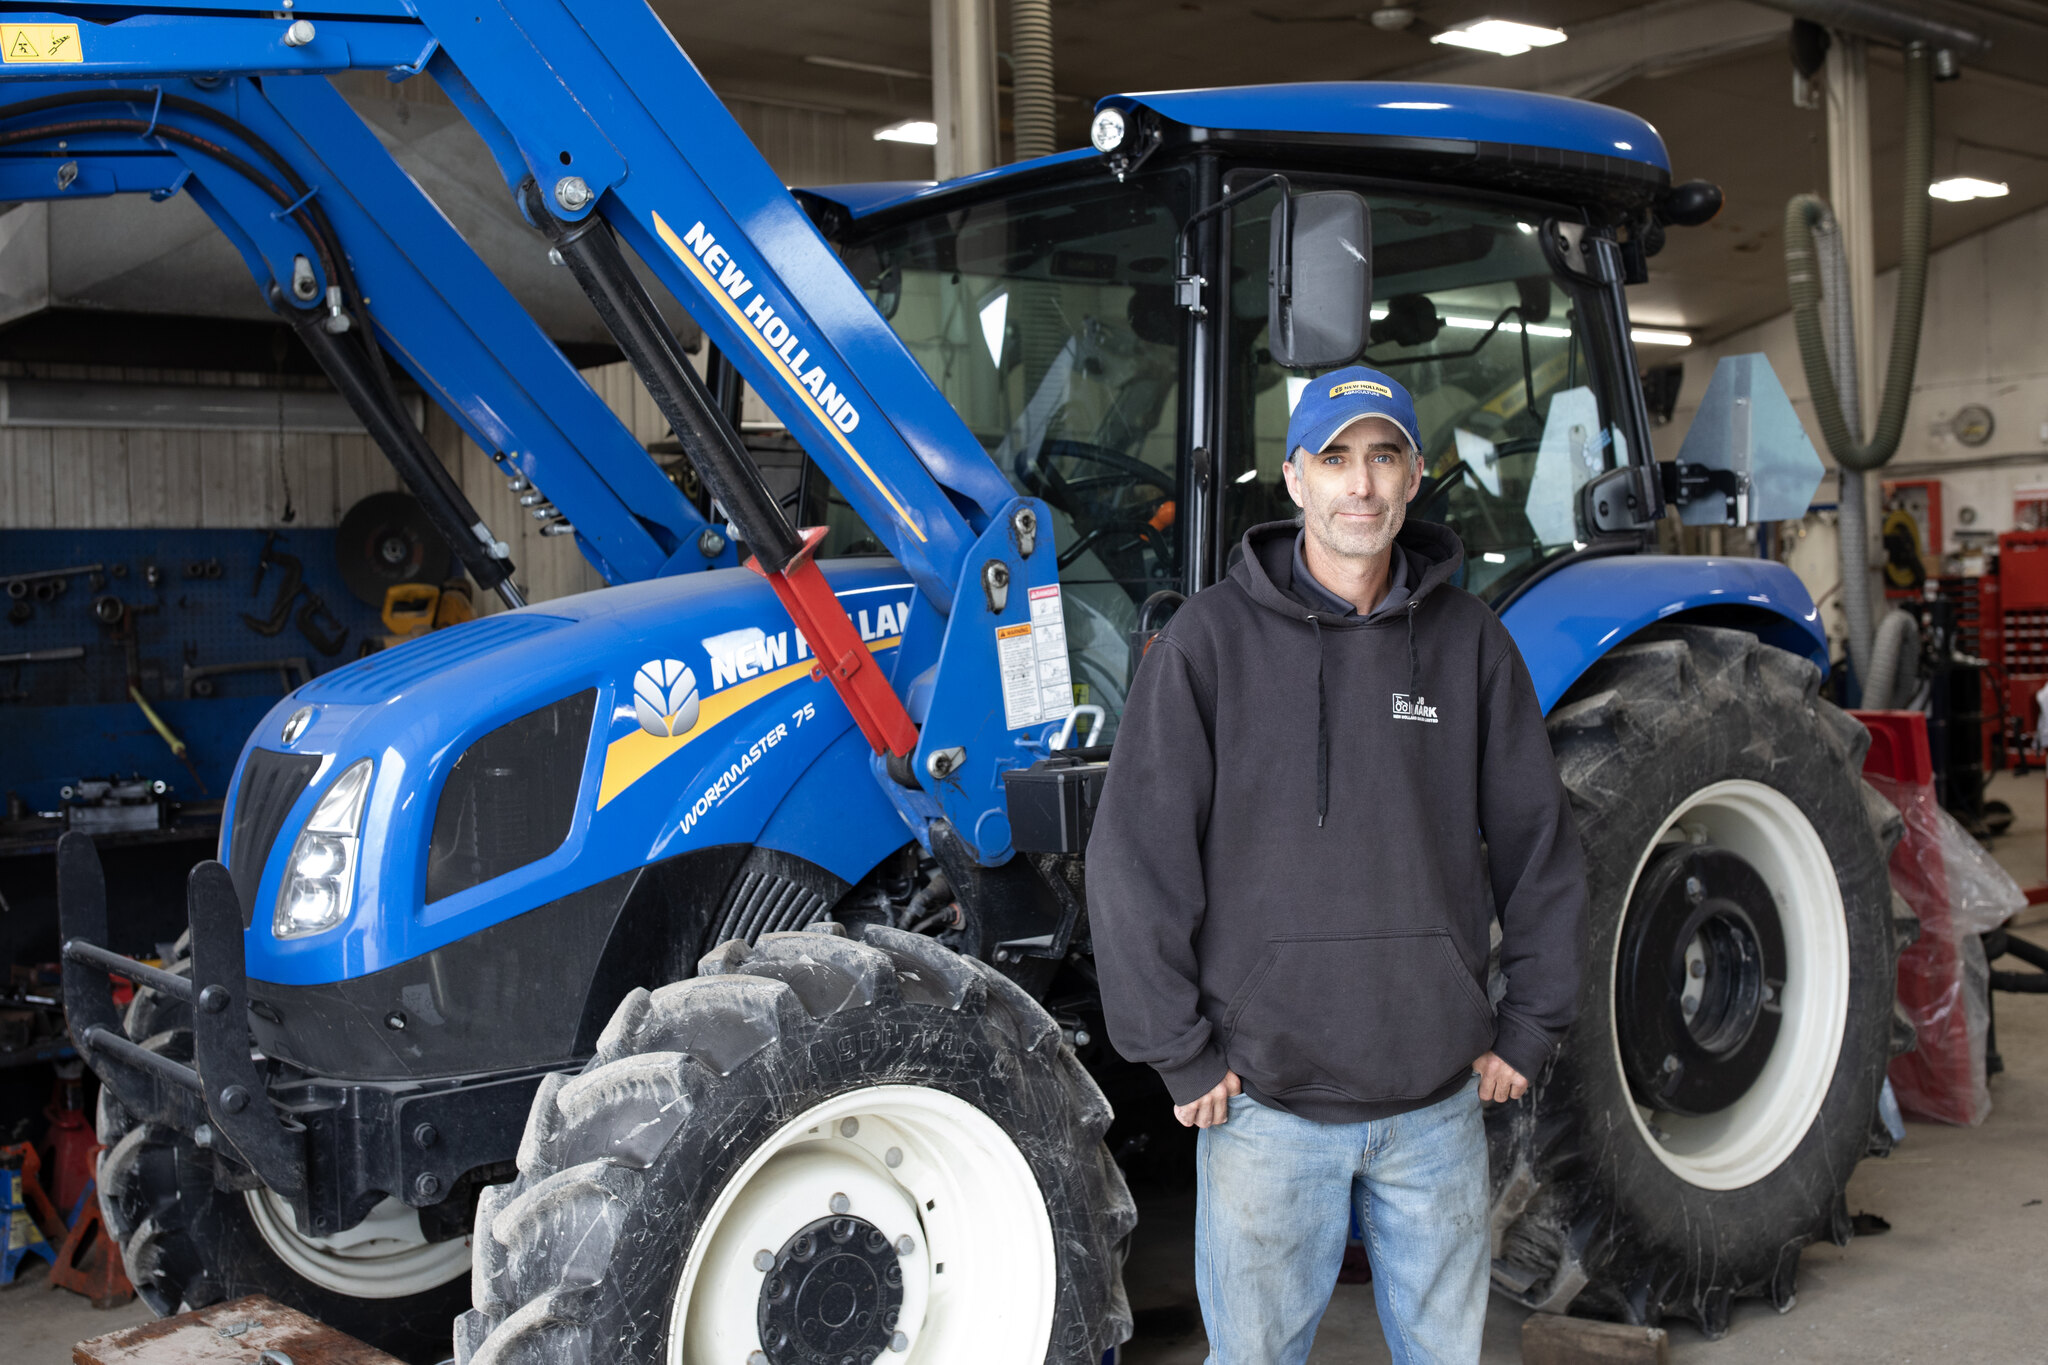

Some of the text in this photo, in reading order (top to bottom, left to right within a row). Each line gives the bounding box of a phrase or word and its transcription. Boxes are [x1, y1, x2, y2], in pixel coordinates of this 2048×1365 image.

[684, 221, 860, 434] NEW HOLLAND
[1360, 385, 1387, 394] HOLLAND
[710, 631, 787, 691] NEW
[680, 702, 816, 834] WORKMASTER 75
